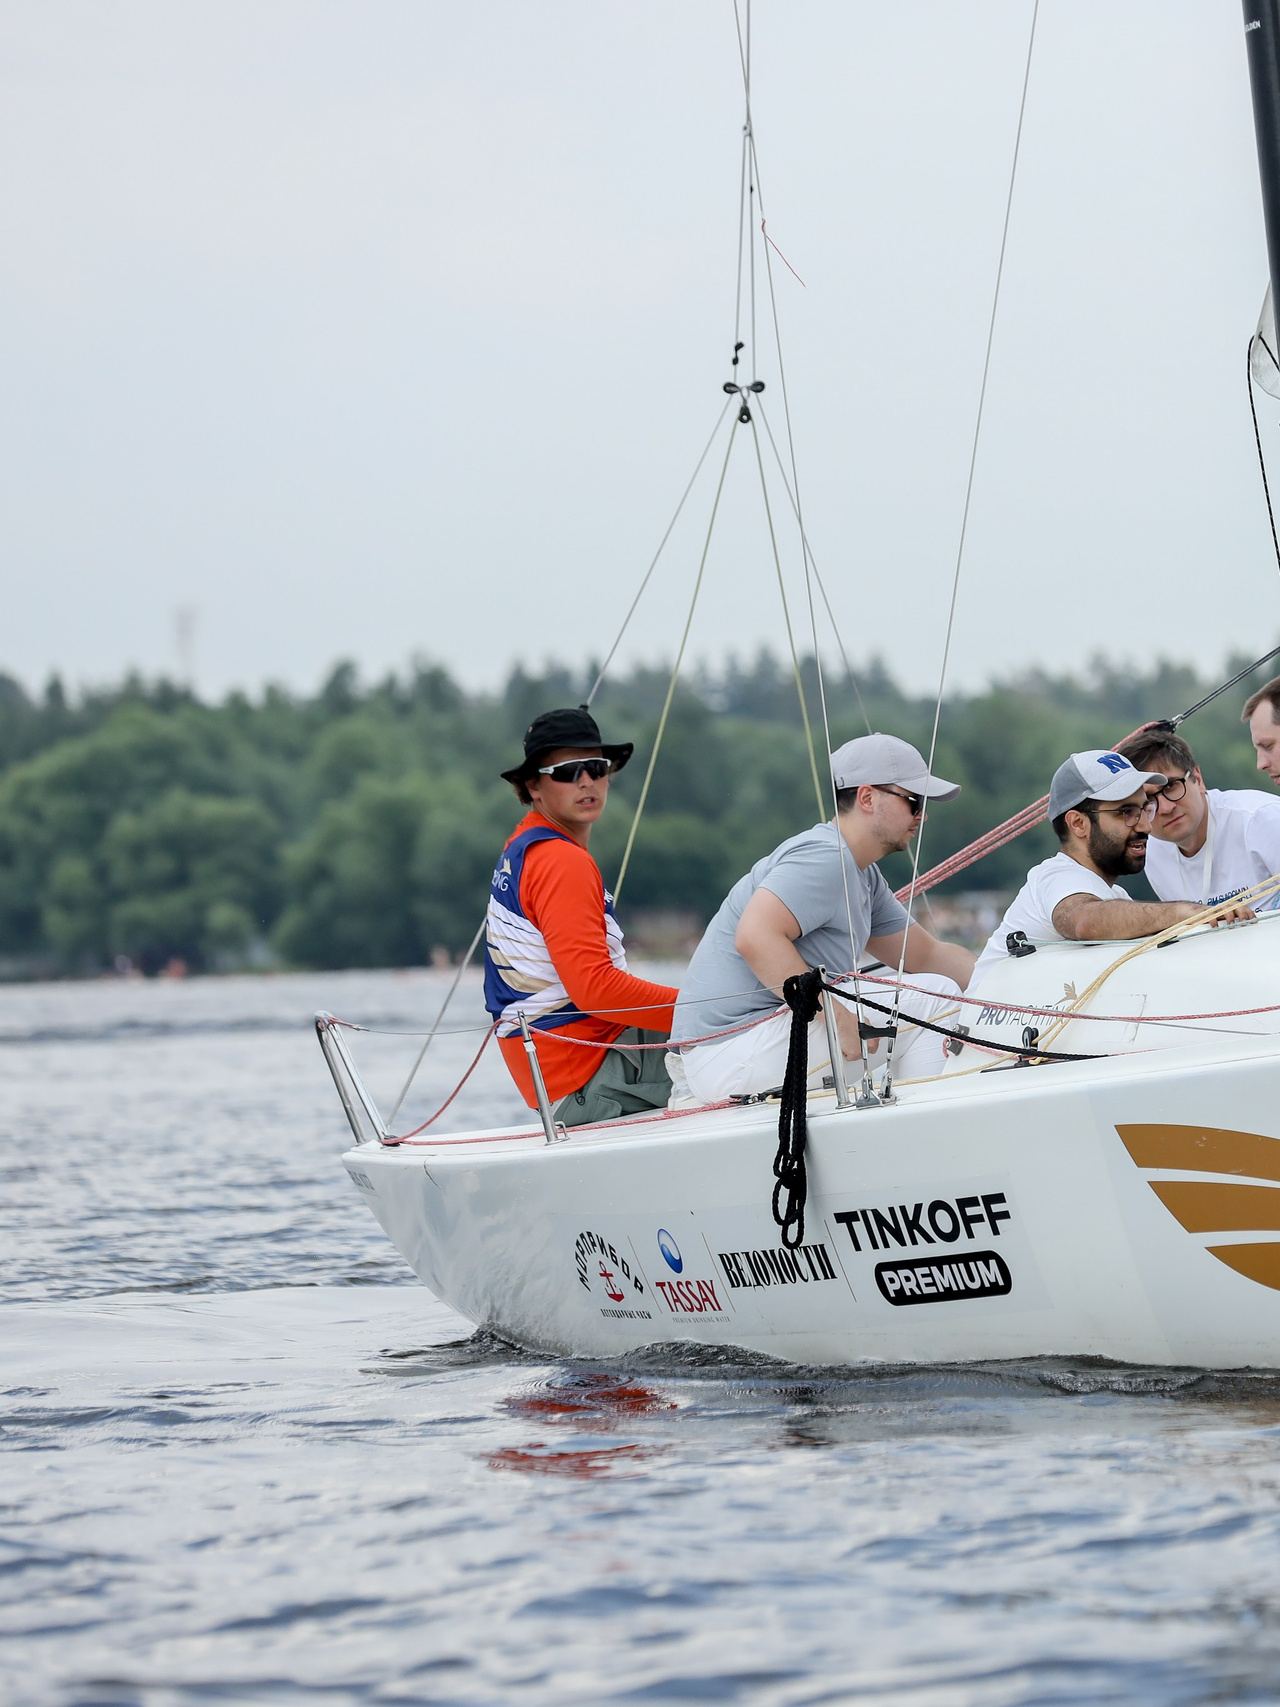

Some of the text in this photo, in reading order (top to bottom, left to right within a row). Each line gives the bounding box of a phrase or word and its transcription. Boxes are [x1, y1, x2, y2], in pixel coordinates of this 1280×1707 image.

[1096, 753, 1131, 774] N
[975, 1004, 1077, 1026] PROYACHTIN
[833, 1192, 1012, 1252] TINKOFF
[717, 1243, 838, 1292] ВЕДОМОСТИ
[881, 1259, 1005, 1298] PREMIUM
[655, 1279, 723, 1313] TASSAY
